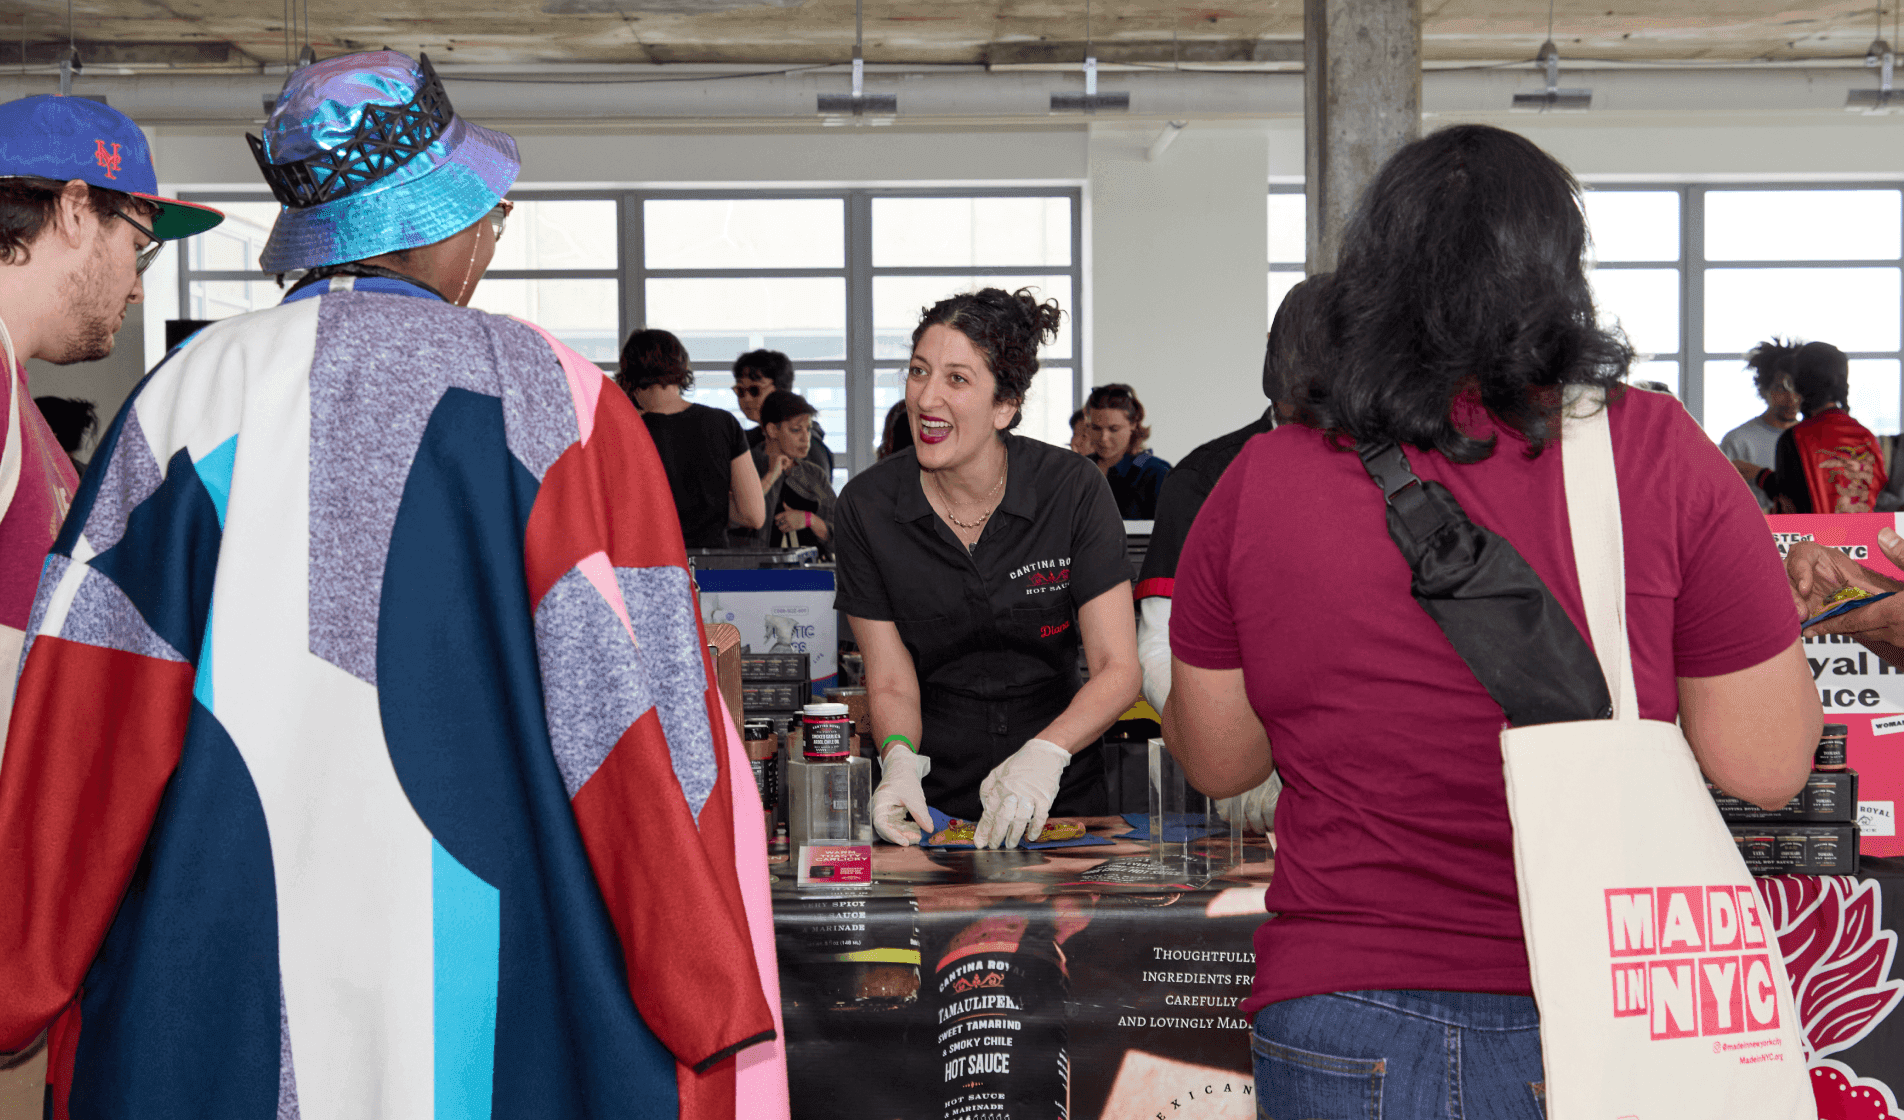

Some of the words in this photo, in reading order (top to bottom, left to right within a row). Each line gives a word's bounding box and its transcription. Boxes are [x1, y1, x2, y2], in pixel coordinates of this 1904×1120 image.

[1773, 533, 1799, 542] STE
[1009, 559, 1055, 580] CANTINA
[1026, 587, 1046, 595] HOT
[1049, 582, 1070, 592] SAU
[1040, 620, 1070, 638] Diana
[1807, 652, 1868, 680] yal
[1860, 806, 1891, 818] ROYAL
[828, 911, 866, 919] SAUCE
[1606, 888, 1766, 955] MADE
[812, 924, 865, 933] MARINADE
[1153, 946, 1257, 963] THOUGHTFULLY
[939, 960, 983, 992] CANTINA
[1142, 971, 1232, 985] INGREDIENTS
[1165, 995, 1238, 1007] CAREFULLY
[1613, 965, 1646, 1014] IN
[1650, 957, 1778, 1037] NYC
[938, 1024, 963, 1043] SWEET
[966, 1019, 1022, 1031] TAMARIND
[1118, 1016, 1147, 1027] AND
[1149, 1017, 1215, 1029] LOVINGLY
[942, 1049, 948, 1057] &
[949, 1037, 981, 1054] SMOKY
[983, 1036, 1013, 1047] CHILE
[944, 1056, 966, 1083] HOT
[967, 1053, 1010, 1075] SAUCE
[944, 1097, 964, 1108] HOT
[968, 1093, 1005, 1101] SAUCE
[1156, 1083, 1252, 1120] EXICAN
[952, 1103, 1004, 1116] MARINADE
